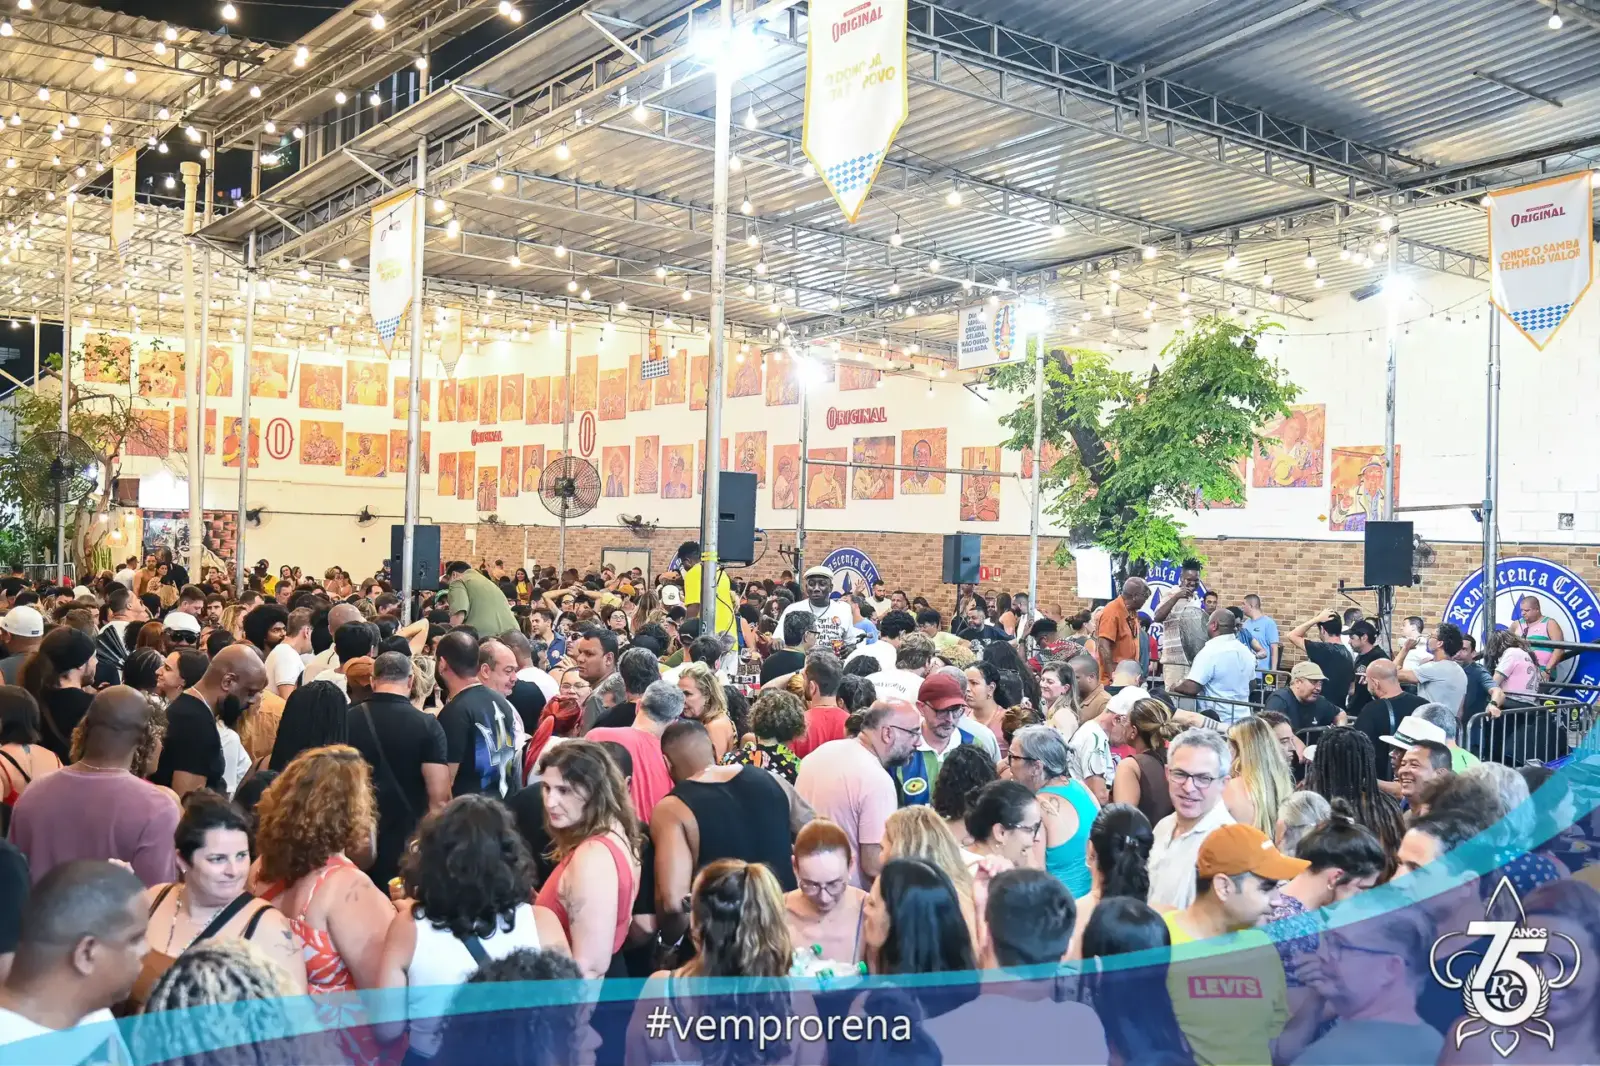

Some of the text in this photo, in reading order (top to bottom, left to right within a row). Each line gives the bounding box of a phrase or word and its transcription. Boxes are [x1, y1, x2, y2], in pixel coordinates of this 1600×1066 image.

[832, 6, 883, 43] ORIGINAL
[1511, 206, 1566, 228] ORIGINAL
[1501, 238, 1580, 261] ONDE O SAMBA
[1499, 260, 1520, 271] TEM
[1521, 254, 1546, 268] MAIS
[826, 406, 888, 431] ORIGINAL
[1552, 575, 1596, 631] Clube
